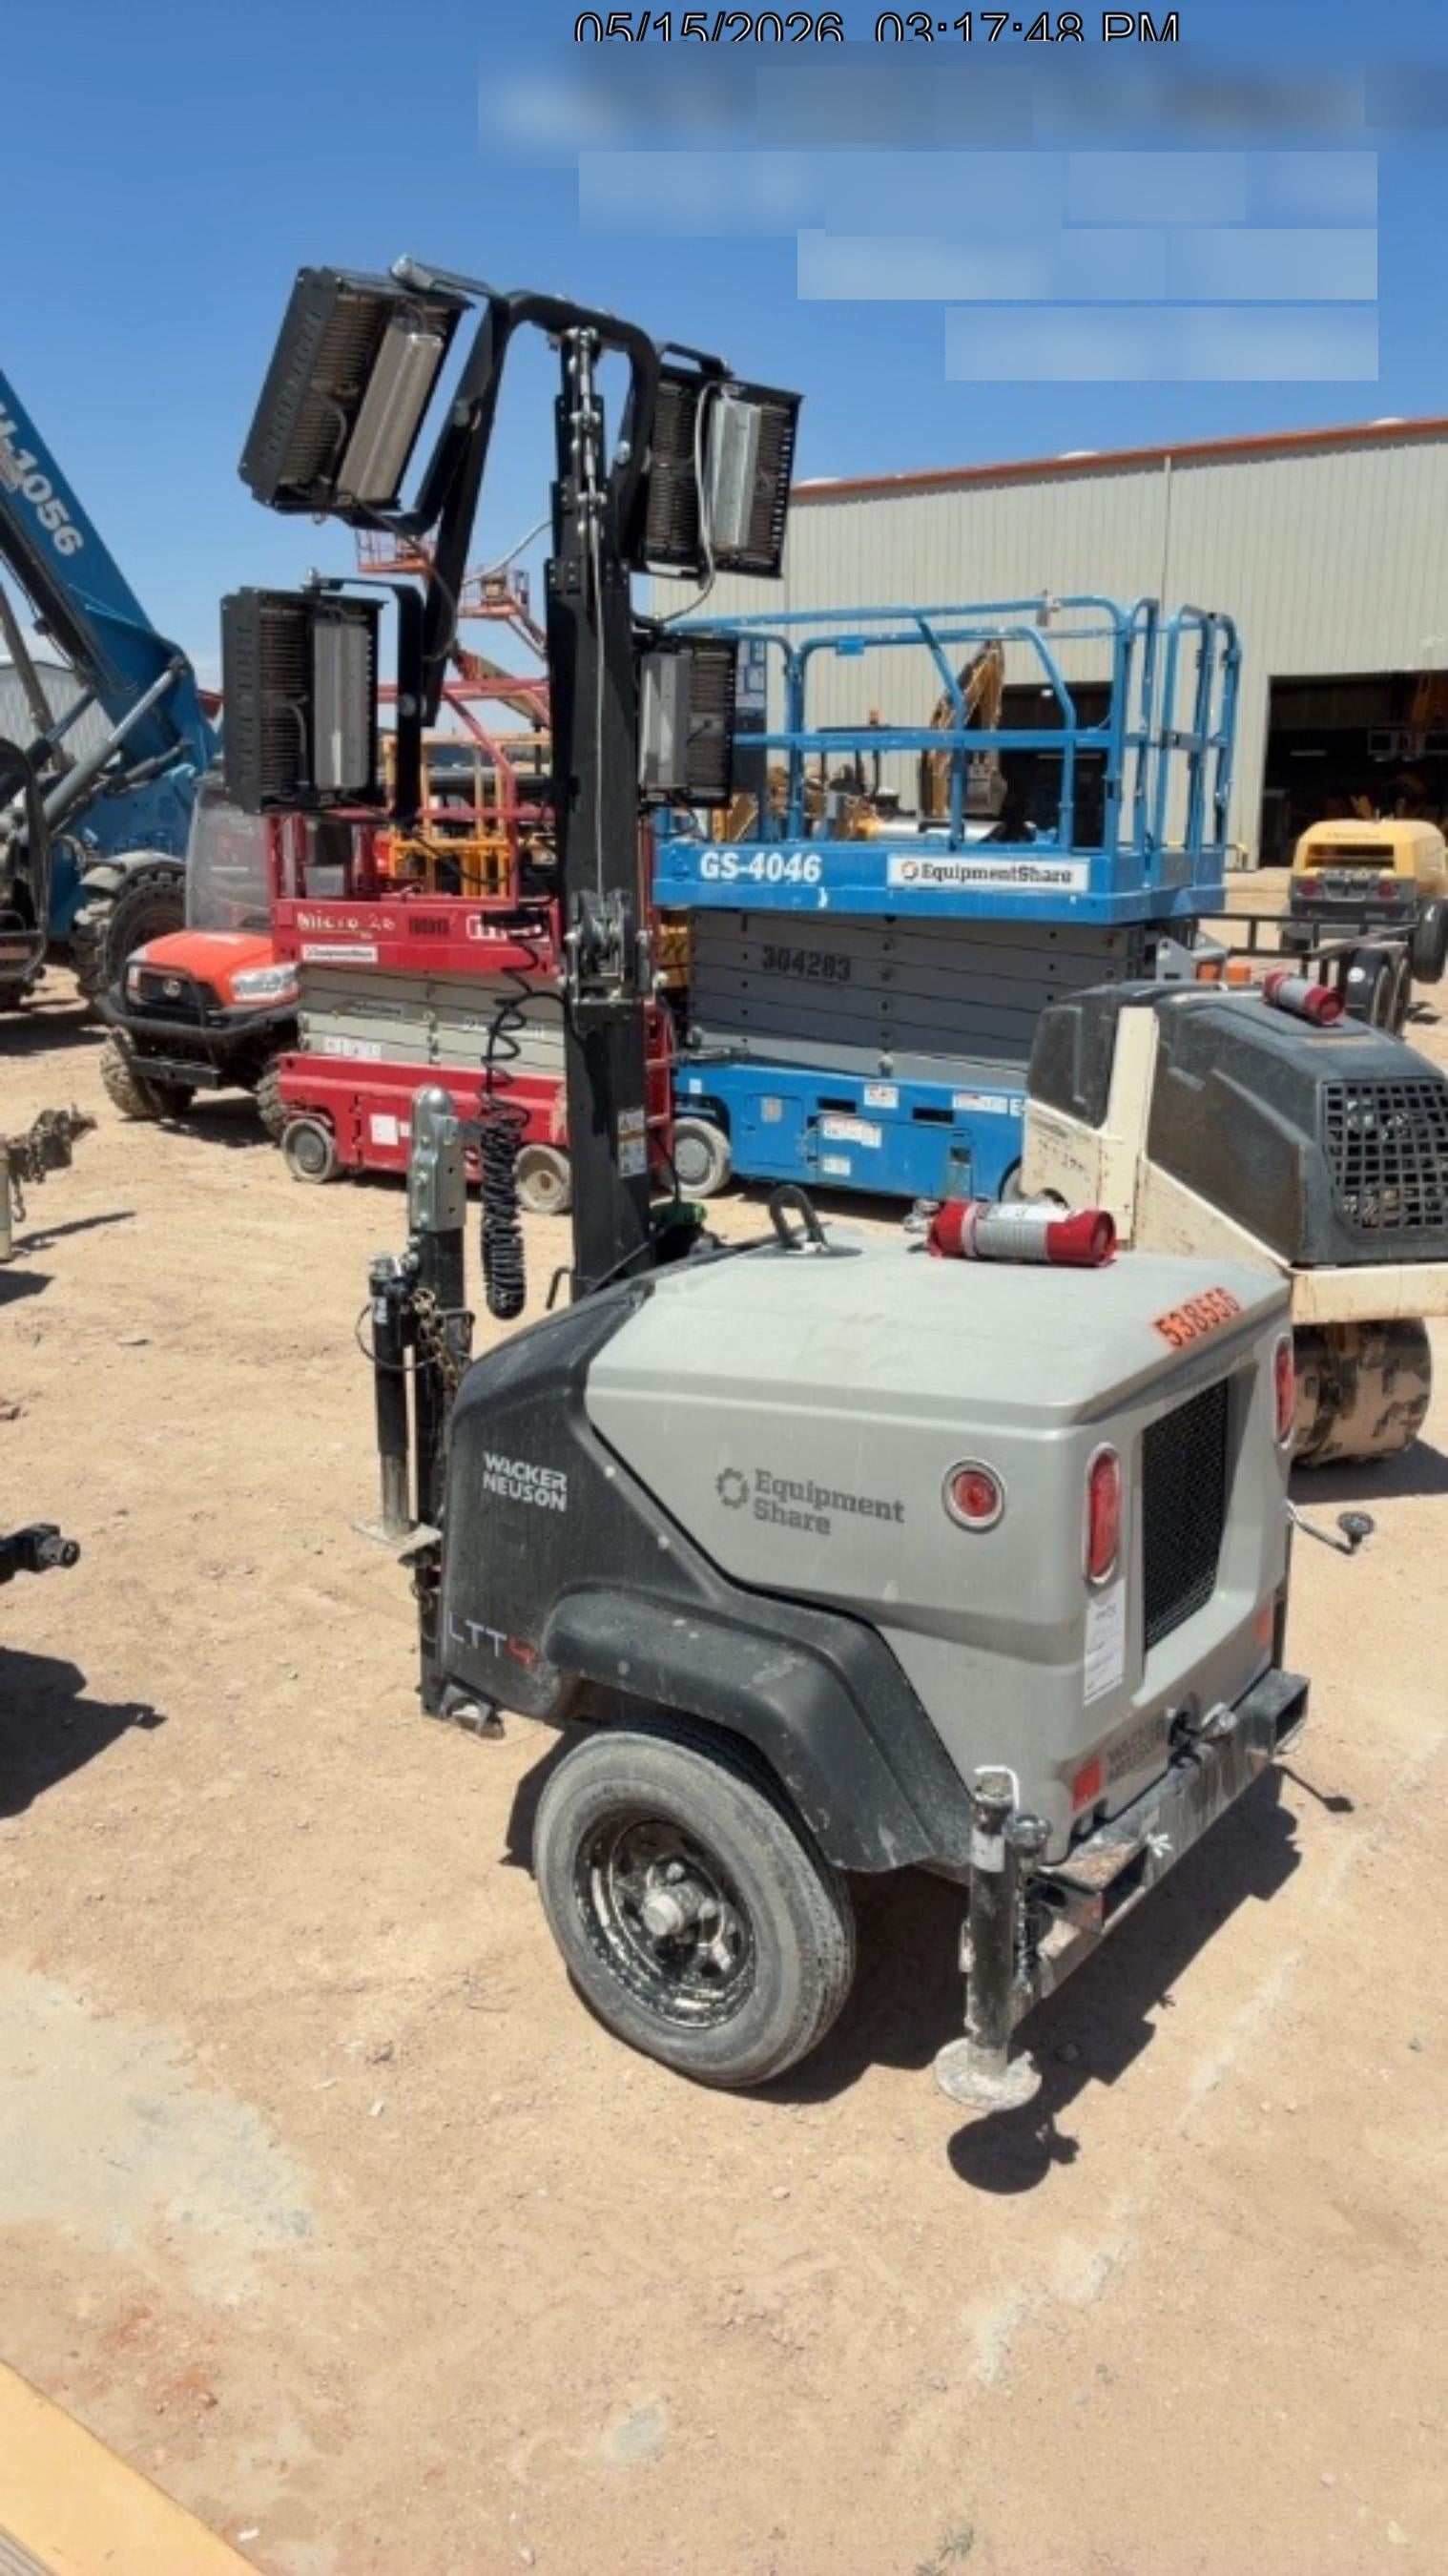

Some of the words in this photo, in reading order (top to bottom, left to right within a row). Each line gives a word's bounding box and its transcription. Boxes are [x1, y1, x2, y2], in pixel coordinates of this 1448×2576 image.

[700, 852, 821, 883] GS-4046
[921, 863, 1072, 884] EquipmentShare
[483, 1450, 568, 1492] WACKER
[483, 1471, 568, 1512] NEUSON
[753, 1497, 831, 1535] Share
[755, 1467, 905, 1524] Equipment
[448, 1611, 539, 1669] LTT4
